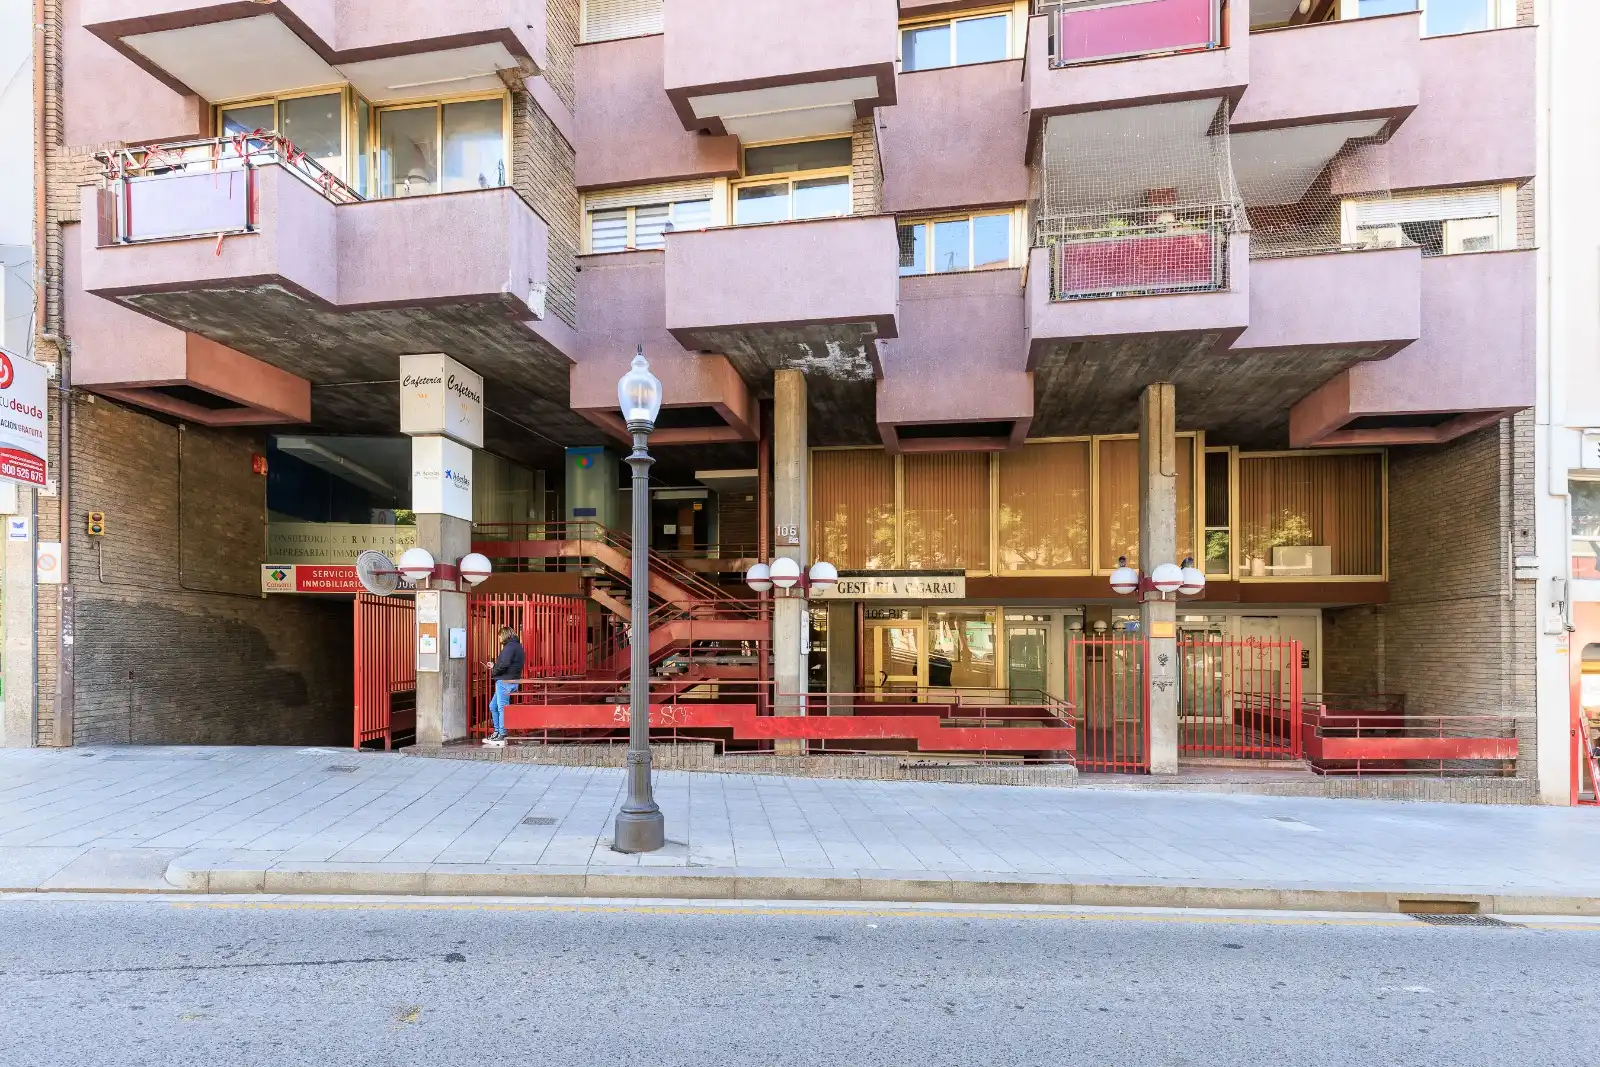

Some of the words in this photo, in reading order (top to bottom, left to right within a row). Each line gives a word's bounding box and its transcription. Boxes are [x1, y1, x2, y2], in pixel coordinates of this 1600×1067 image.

[402, 374, 442, 388] Cafeteria
[447, 374, 481, 404] Cafeteria
[1, 463, 16, 475] 900
[16, 466, 30, 479] 525
[30, 471, 44, 482] 675
[776, 526, 797, 539] 106
[312, 570, 359, 579] SERVICIOS
[865, 608, 885, 619] 106
